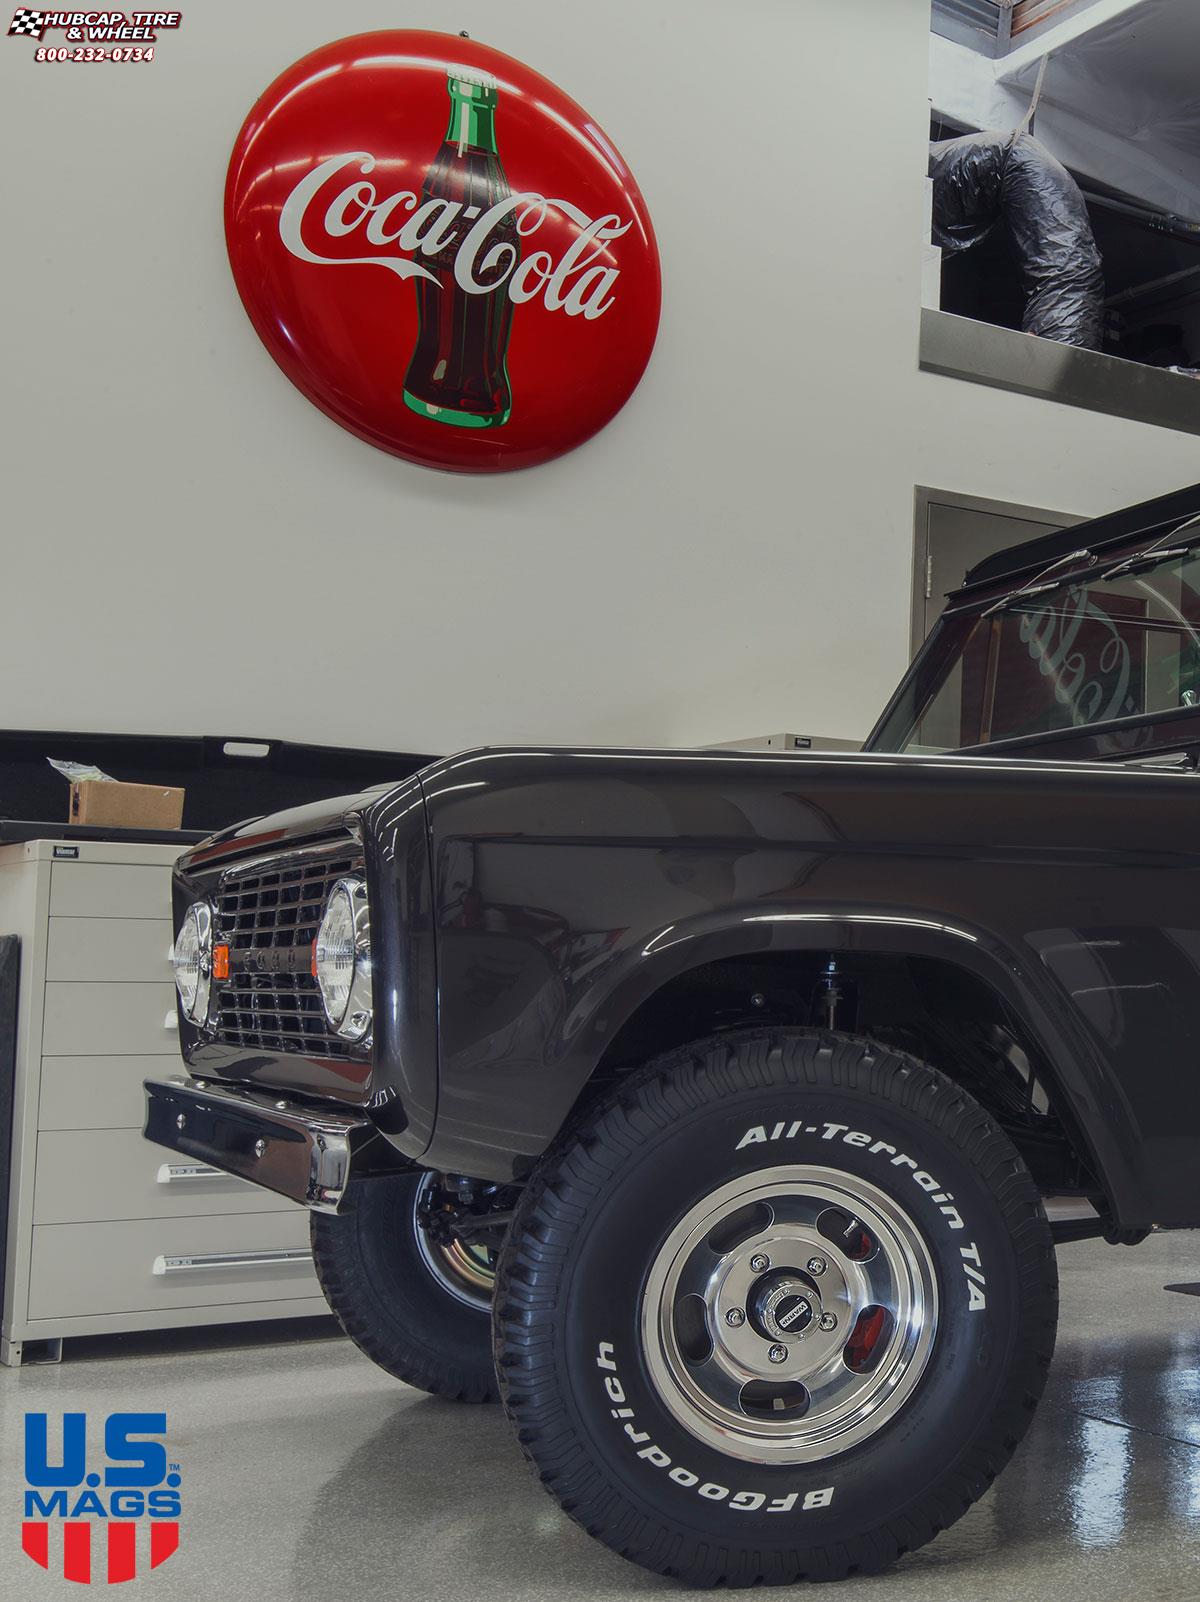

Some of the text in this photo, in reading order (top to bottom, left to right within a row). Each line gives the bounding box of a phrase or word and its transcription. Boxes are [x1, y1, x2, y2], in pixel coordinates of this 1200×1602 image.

[279, 151, 634, 321] Coca-Cola
[734, 1120, 987, 1313] All-Terrain T/A
[783, 1302, 808, 1325] WARN
[596, 1341, 836, 1513] BFGoodrich
